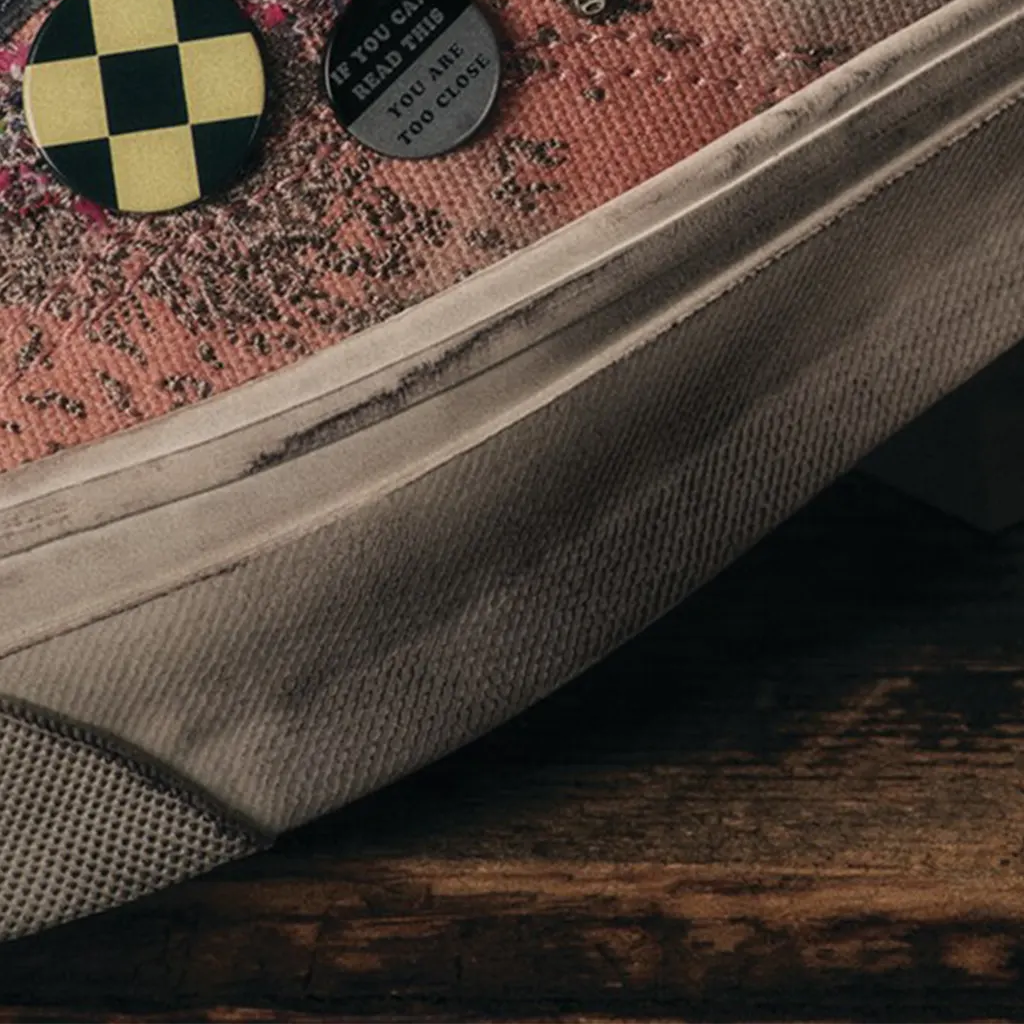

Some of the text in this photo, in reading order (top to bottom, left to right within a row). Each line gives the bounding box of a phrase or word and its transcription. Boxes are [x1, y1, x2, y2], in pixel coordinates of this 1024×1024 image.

[331, 62, 352, 85] IF
[351, 23, 392, 63] YOU
[352, 7, 445, 100] READ THIS
[387, 42, 464, 119] YOU ARE
[397, 53, 491, 145] TOO CLOSE
